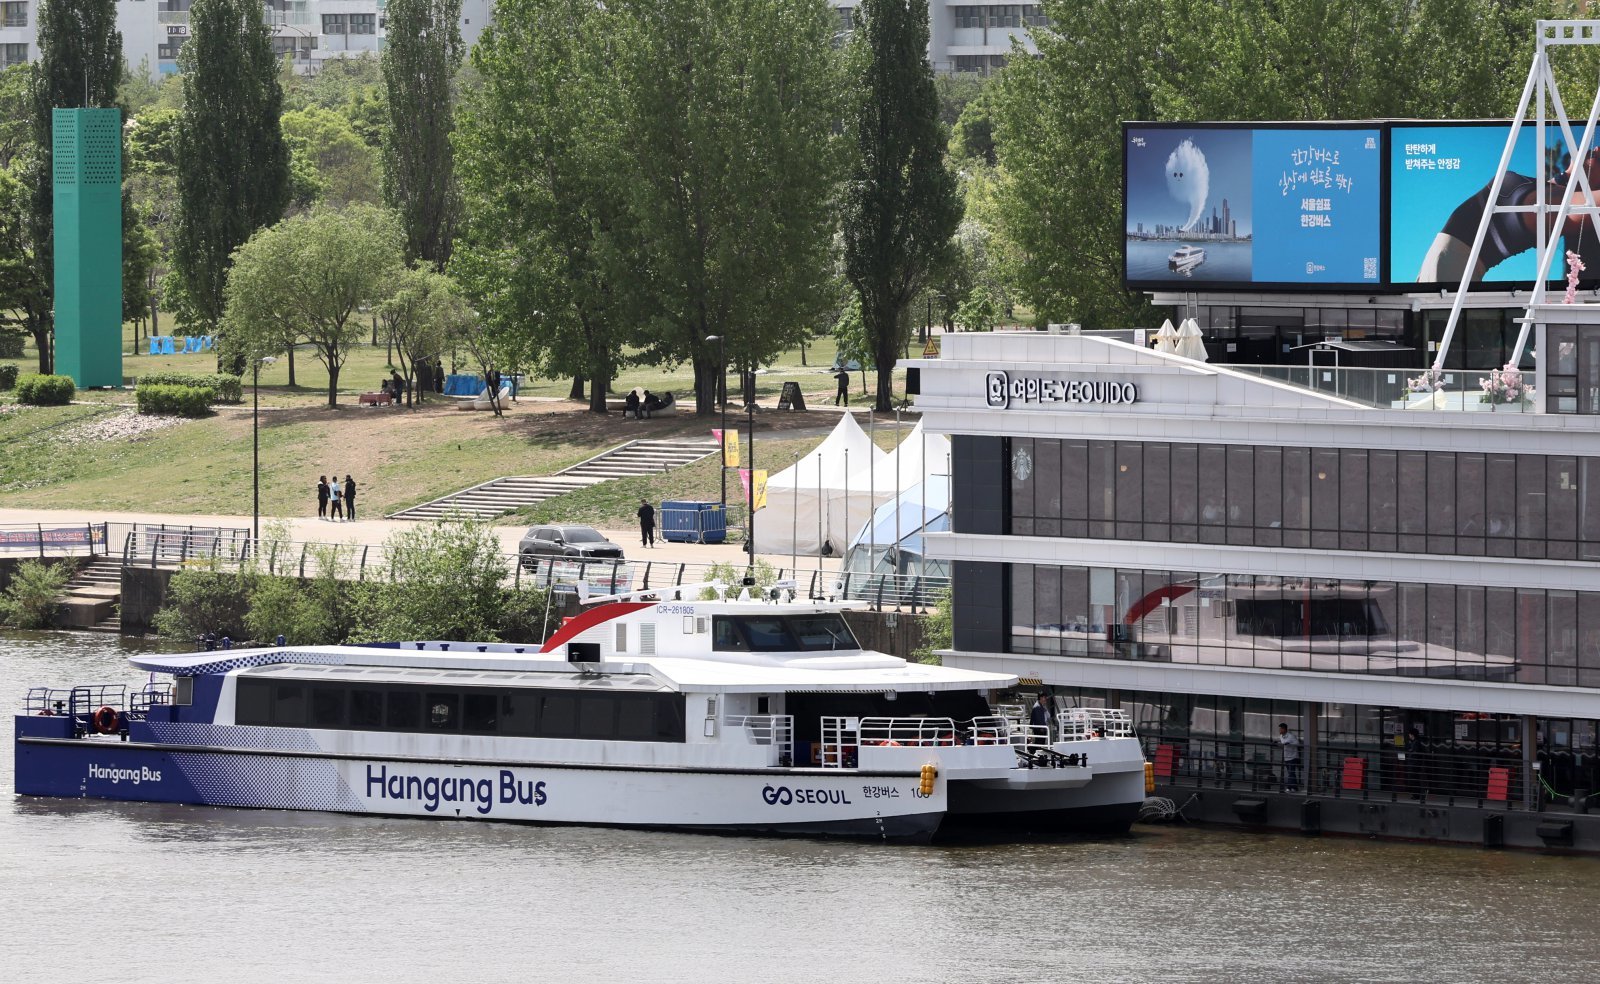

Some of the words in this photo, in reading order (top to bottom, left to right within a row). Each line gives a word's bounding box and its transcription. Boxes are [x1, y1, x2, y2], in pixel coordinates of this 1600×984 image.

[1291, 145, 1340, 166] 한강버스로
[1405, 144, 1436, 155] 탄탄하게
[1405, 158, 1436, 170] 받쳐주는
[1437, 158, 1460, 170] 안정감
[1279, 170, 1308, 196] 일상에
[1310, 166, 1333, 189] 쉼표를
[1301, 198, 1331, 211] 서울쉼표
[1301, 214, 1331, 228] 한강버스
[1013, 378, 1055, 403] 여의도
[1059, 381, 1137, 404] YEOUIDO
[656, 605, 694, 615] ICR-261805
[88, 763, 140, 785] Hangang
[142, 766, 161, 781] Bus
[366, 764, 493, 814] Hangang
[499, 770, 547, 806] Bus
[862, 786, 900, 799] 한강버스
[795, 789, 851, 804] SEOUL
